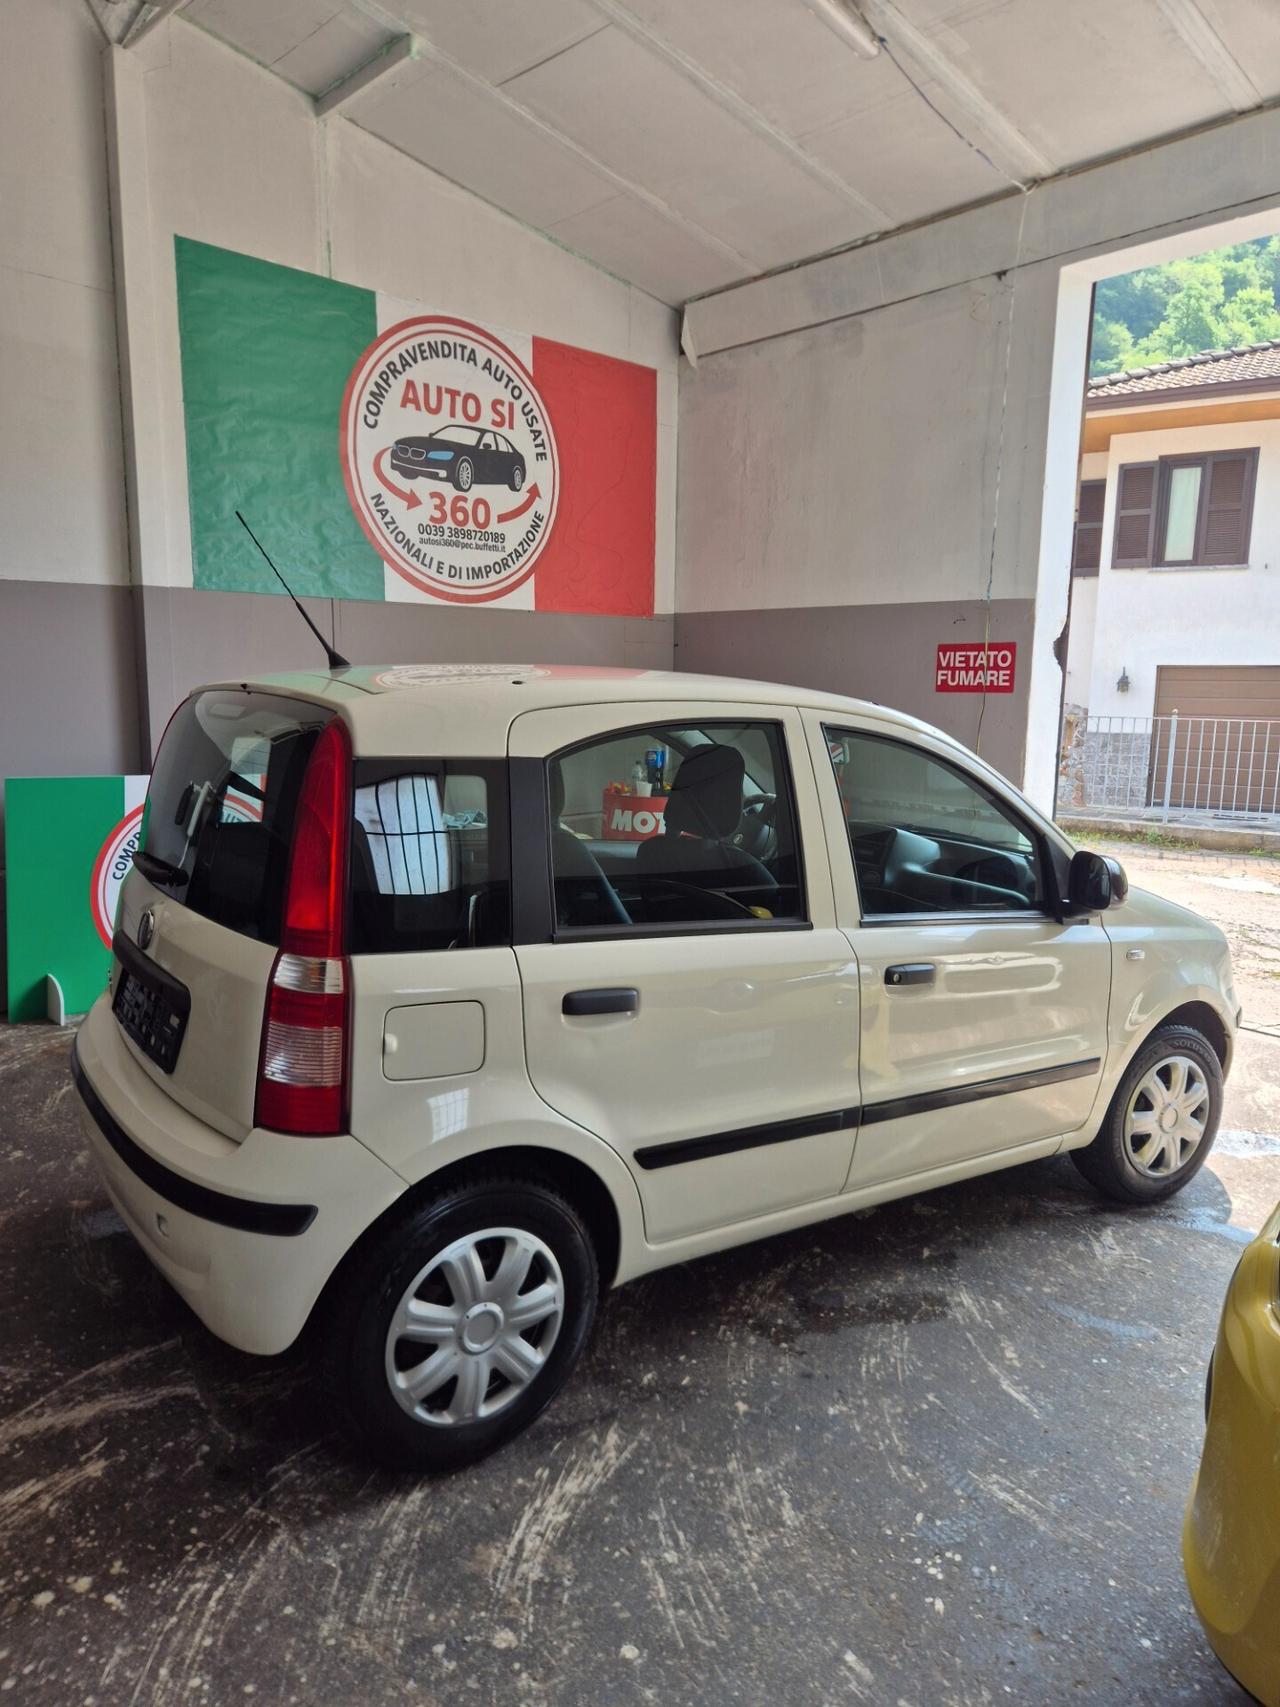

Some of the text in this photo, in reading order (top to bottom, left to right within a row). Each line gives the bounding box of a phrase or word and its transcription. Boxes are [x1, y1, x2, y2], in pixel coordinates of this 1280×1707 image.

[363, 340, 547, 462] COMPRAVENDITA AUTO USATE
[400, 379, 515, 430] AUTO SI
[428, 491, 491, 530] 360
[370, 493, 545, 580] NAZIONALI E DI IMPORTAZIONE
[417, 523, 506, 544] 0039 3898720189
[937, 670, 1010, 686] FUMARE
[939, 650, 1012, 667] VIETATO
